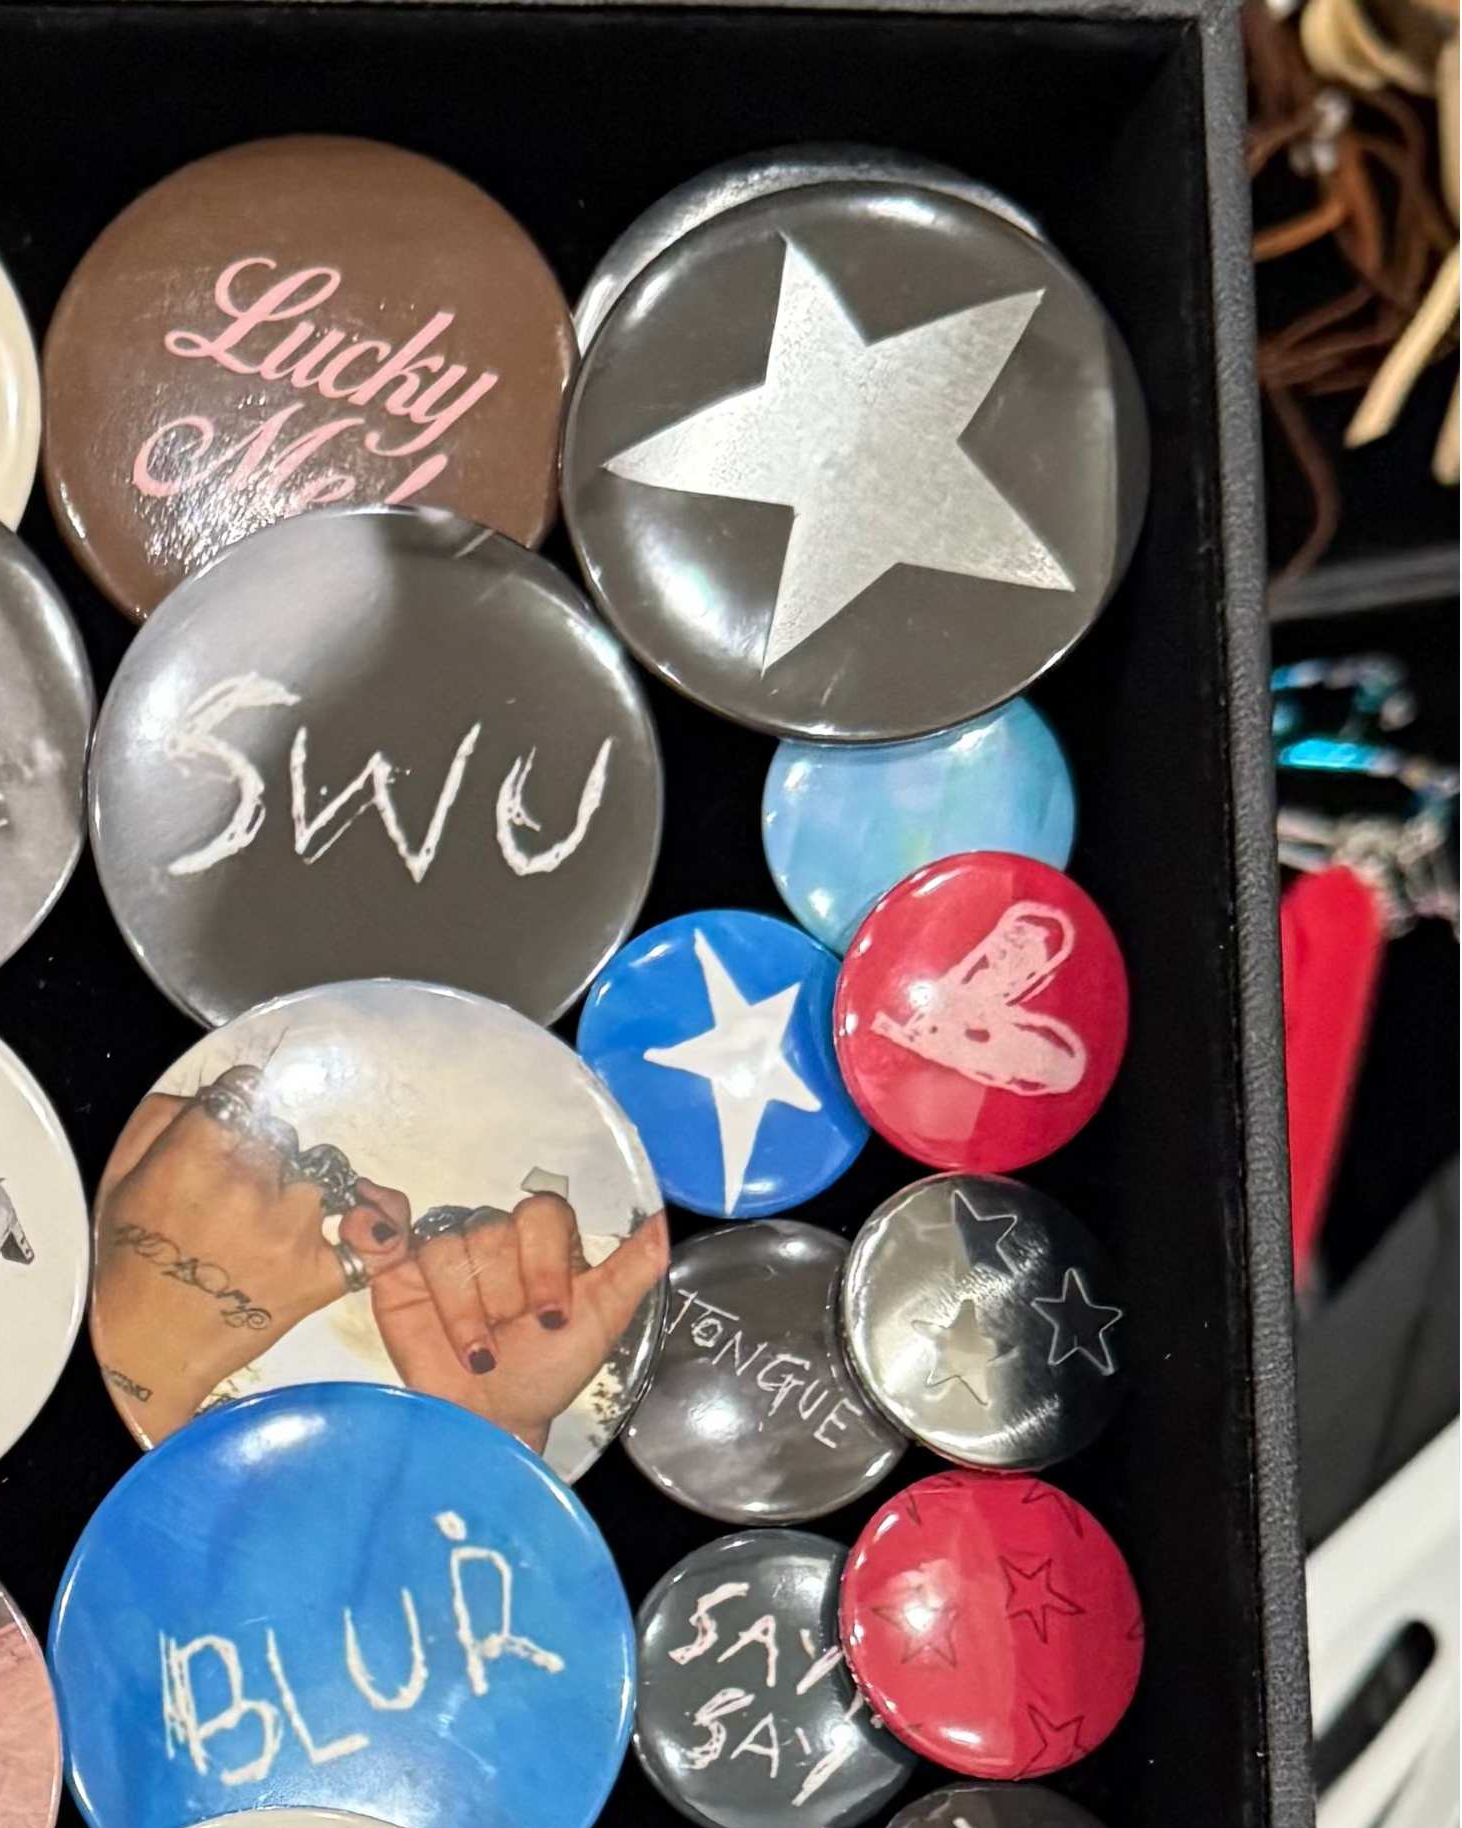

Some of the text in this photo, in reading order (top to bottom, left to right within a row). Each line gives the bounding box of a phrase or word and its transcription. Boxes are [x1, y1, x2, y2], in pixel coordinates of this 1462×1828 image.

[164, 256, 501, 457] Lucky
[167, 670, 617, 884] SWU
[664, 1288, 864, 1449] TONGUE
[159, 1510, 565, 1786] BLUR
[668, 1581, 844, 1695] SAY
[679, 1687, 864, 1807] SAY
